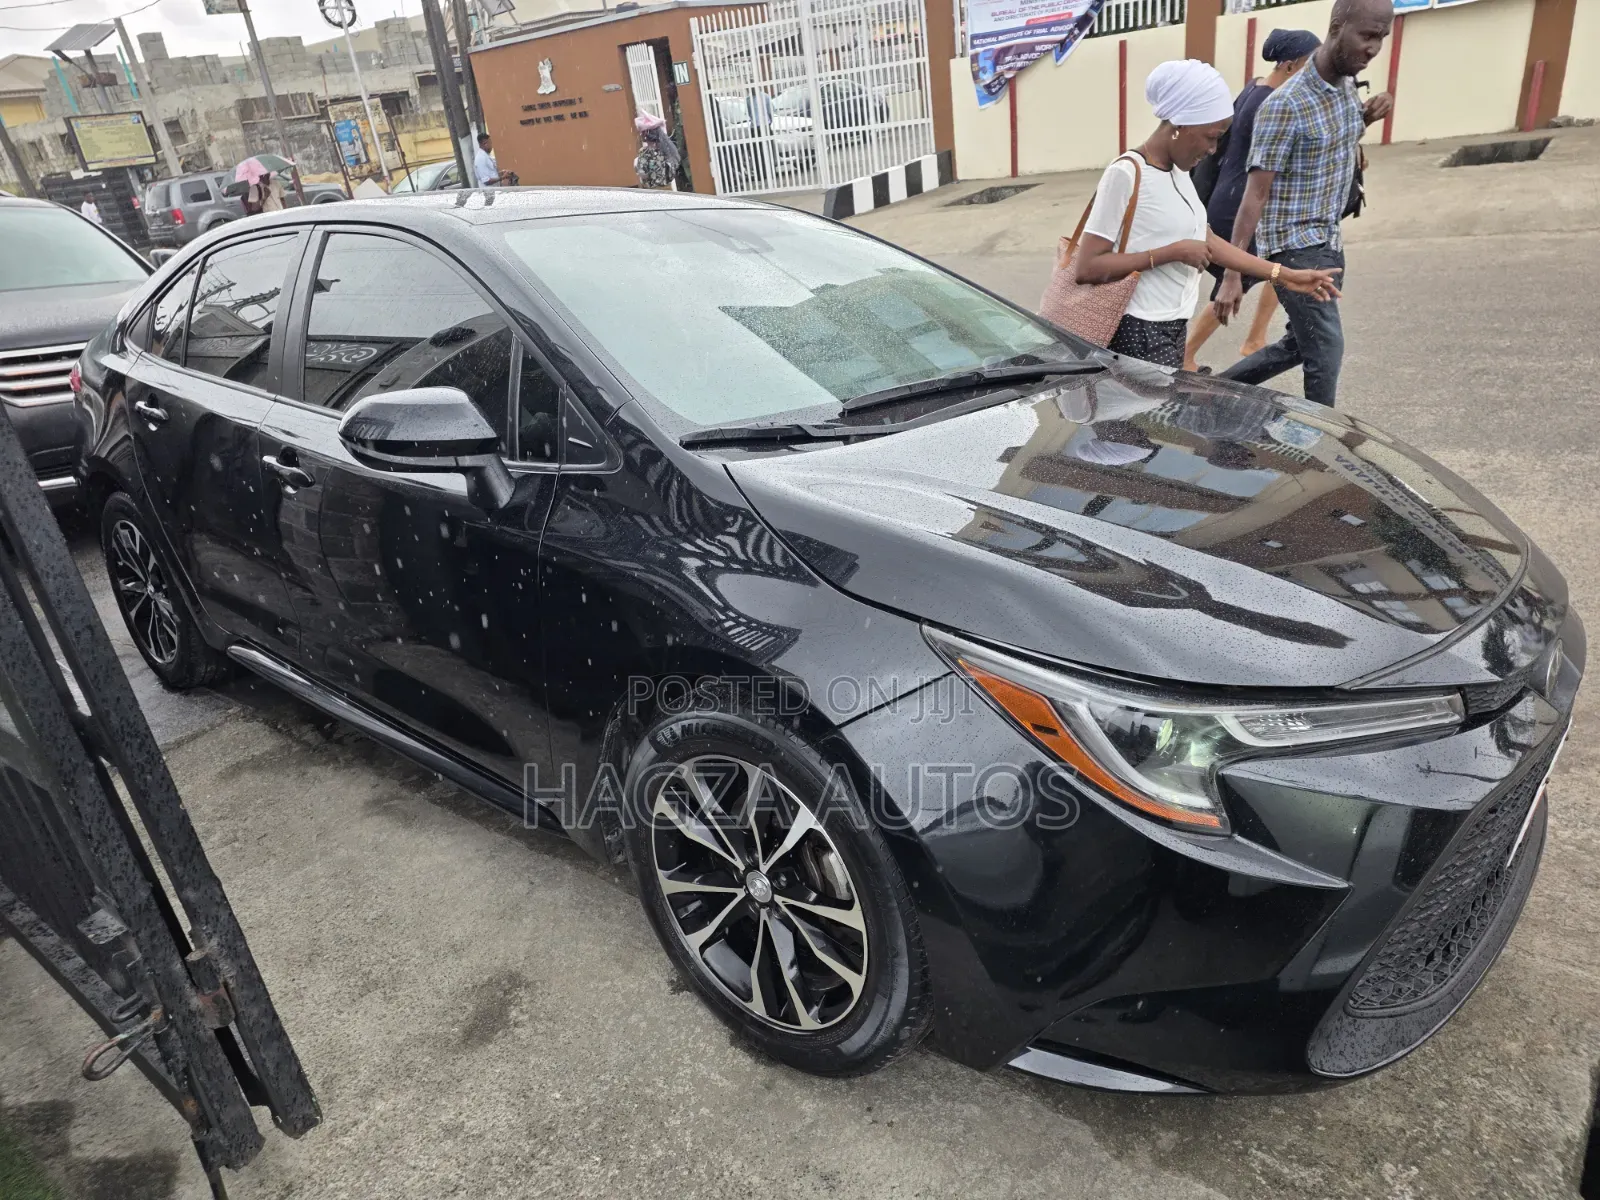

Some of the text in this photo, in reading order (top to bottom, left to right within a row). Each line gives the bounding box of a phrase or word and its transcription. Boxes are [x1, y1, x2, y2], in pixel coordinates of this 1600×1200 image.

[991, 8, 1017, 17] BUREAU
[1040, 1, 1063, 9] PUBLIC
[972, 36, 998, 46] NATIONAL
[998, 32, 1024, 41] INSTITUTE
[1033, 27, 1049, 35] TRIAL
[674, 62, 690, 84] IN
